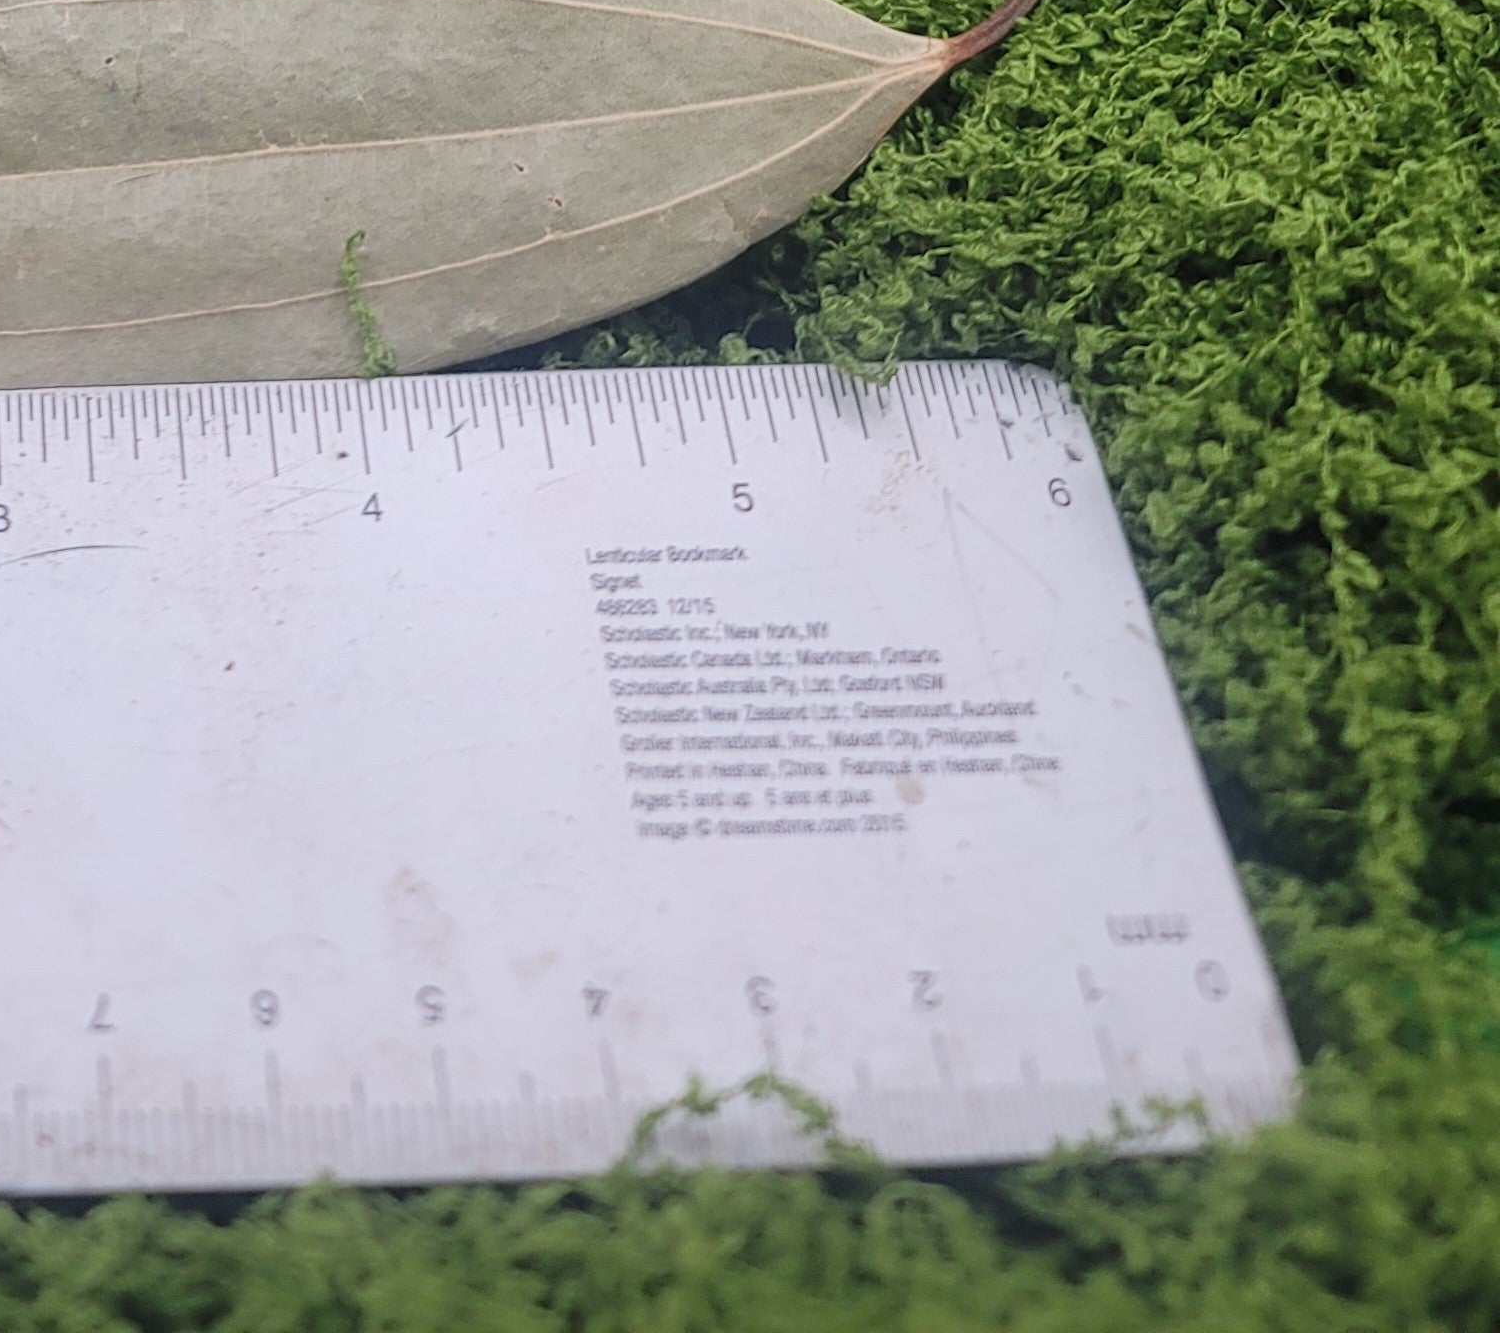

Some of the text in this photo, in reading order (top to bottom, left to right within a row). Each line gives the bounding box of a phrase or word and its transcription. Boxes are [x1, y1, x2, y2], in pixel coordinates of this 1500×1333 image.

[360, 491, 383, 522] 4
[731, 481, 754, 513] 5
[1047, 476, 1071, 507] 6
[250, 988, 280, 1028] 6
[415, 984, 445, 1025] 5
[581, 985, 610, 1018] 4
[745, 975, 778, 1016] 3
[910, 969, 943, 1011] 2
[85, 993, 114, 1033] 7
